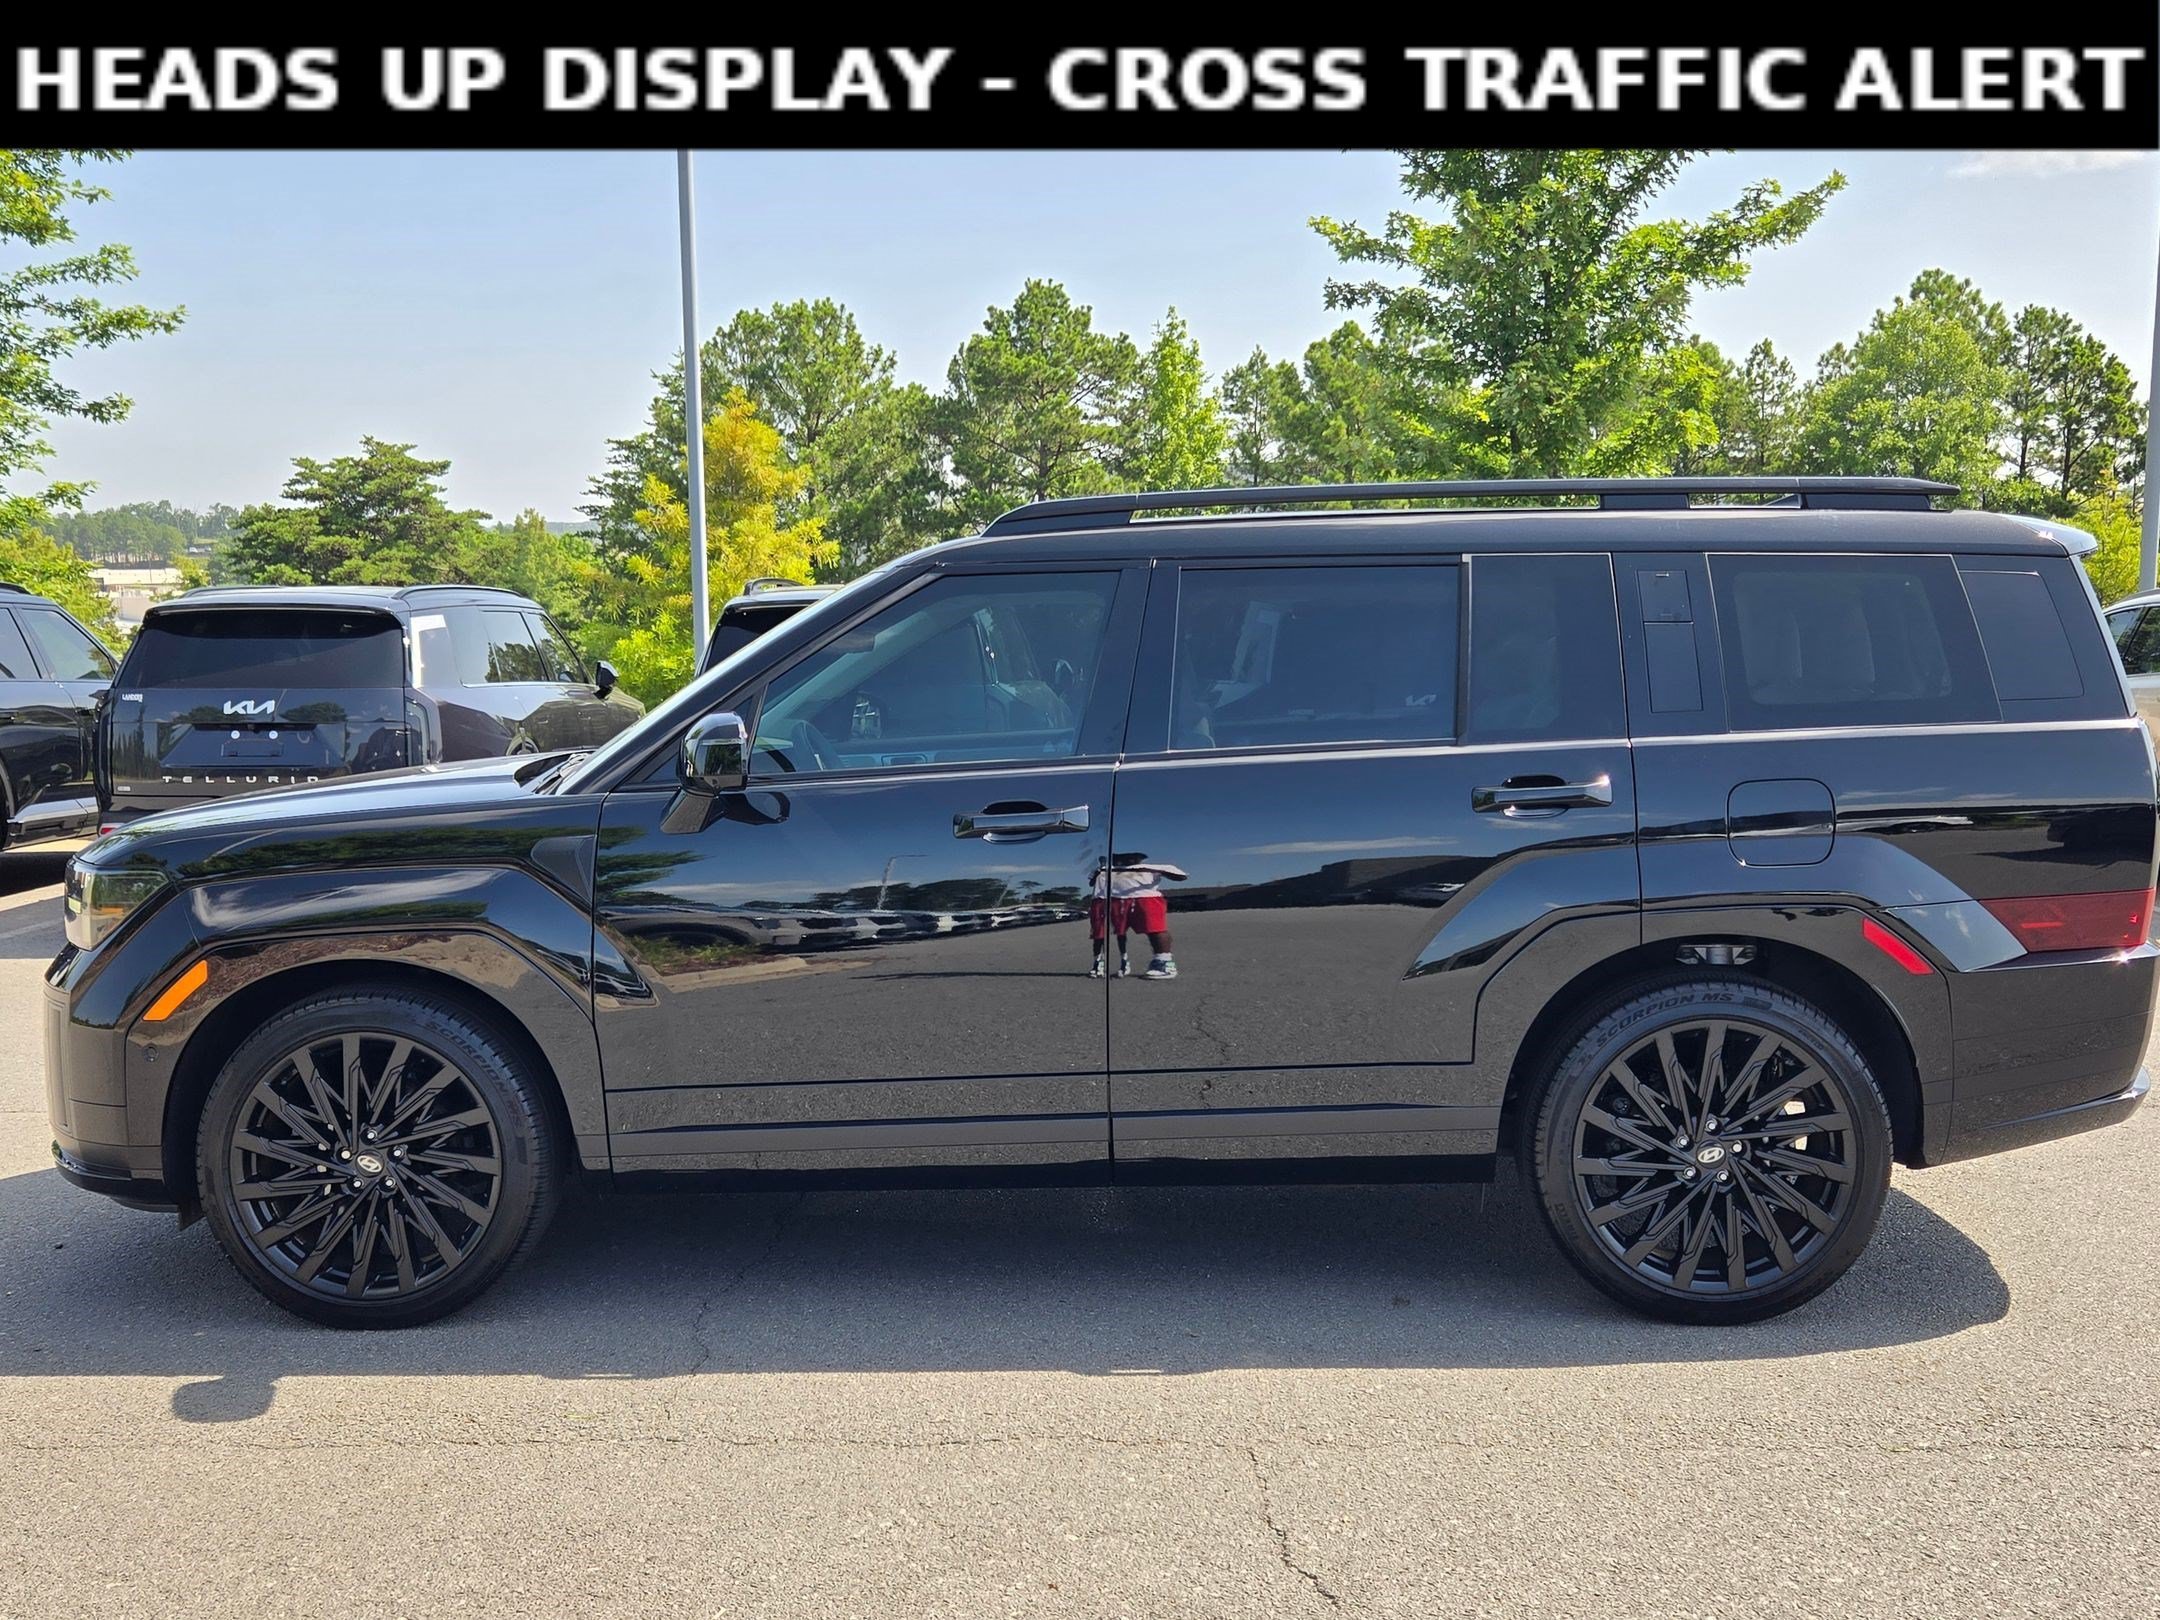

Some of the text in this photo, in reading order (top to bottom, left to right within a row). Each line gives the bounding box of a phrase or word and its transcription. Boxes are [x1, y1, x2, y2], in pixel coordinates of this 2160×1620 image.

[223, 700, 275, 715] KIA
[162, 775, 319, 785] TELLURID
[1596, 992, 1734, 1047] SCORPION MS
